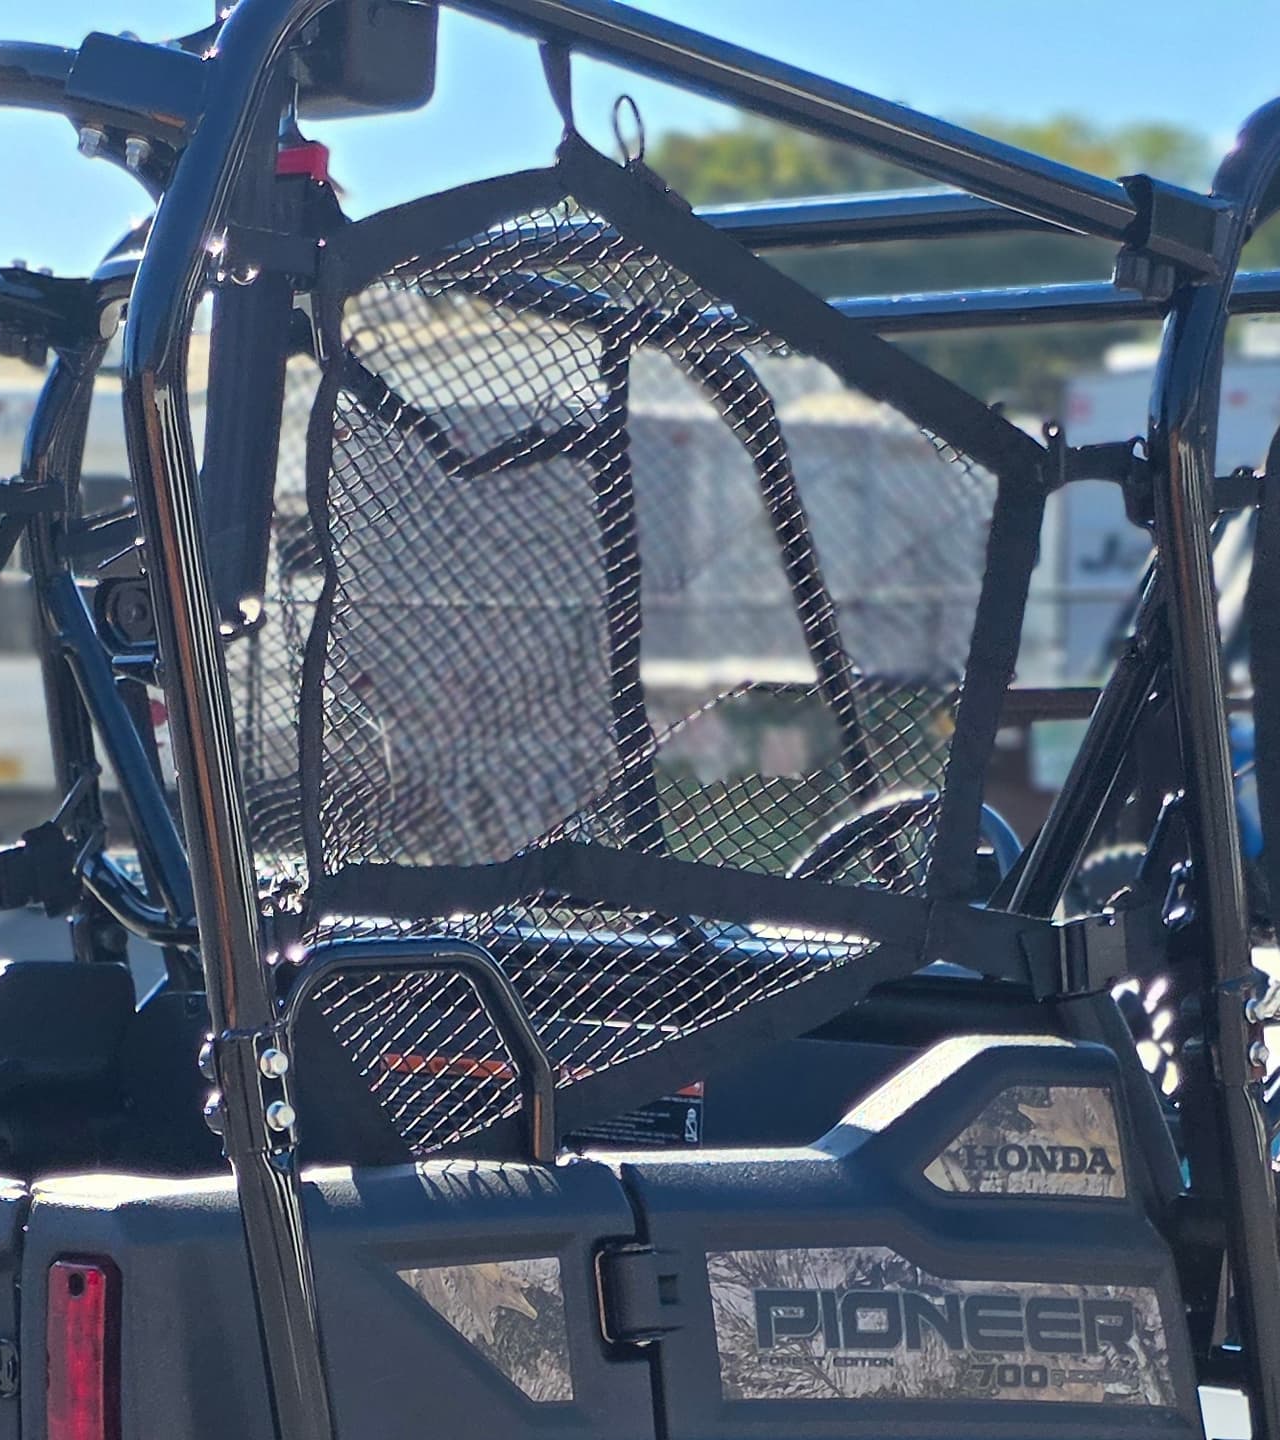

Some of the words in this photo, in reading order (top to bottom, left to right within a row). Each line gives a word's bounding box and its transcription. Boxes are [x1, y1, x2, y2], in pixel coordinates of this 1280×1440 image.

[962, 1143, 1116, 1175] HONDA
[754, 1287, 1138, 1354] PIONEER
[758, 1356, 825, 1367] FOREST
[832, 1356, 896, 1368] EDITION
[968, 1362, 1049, 1388] 700
